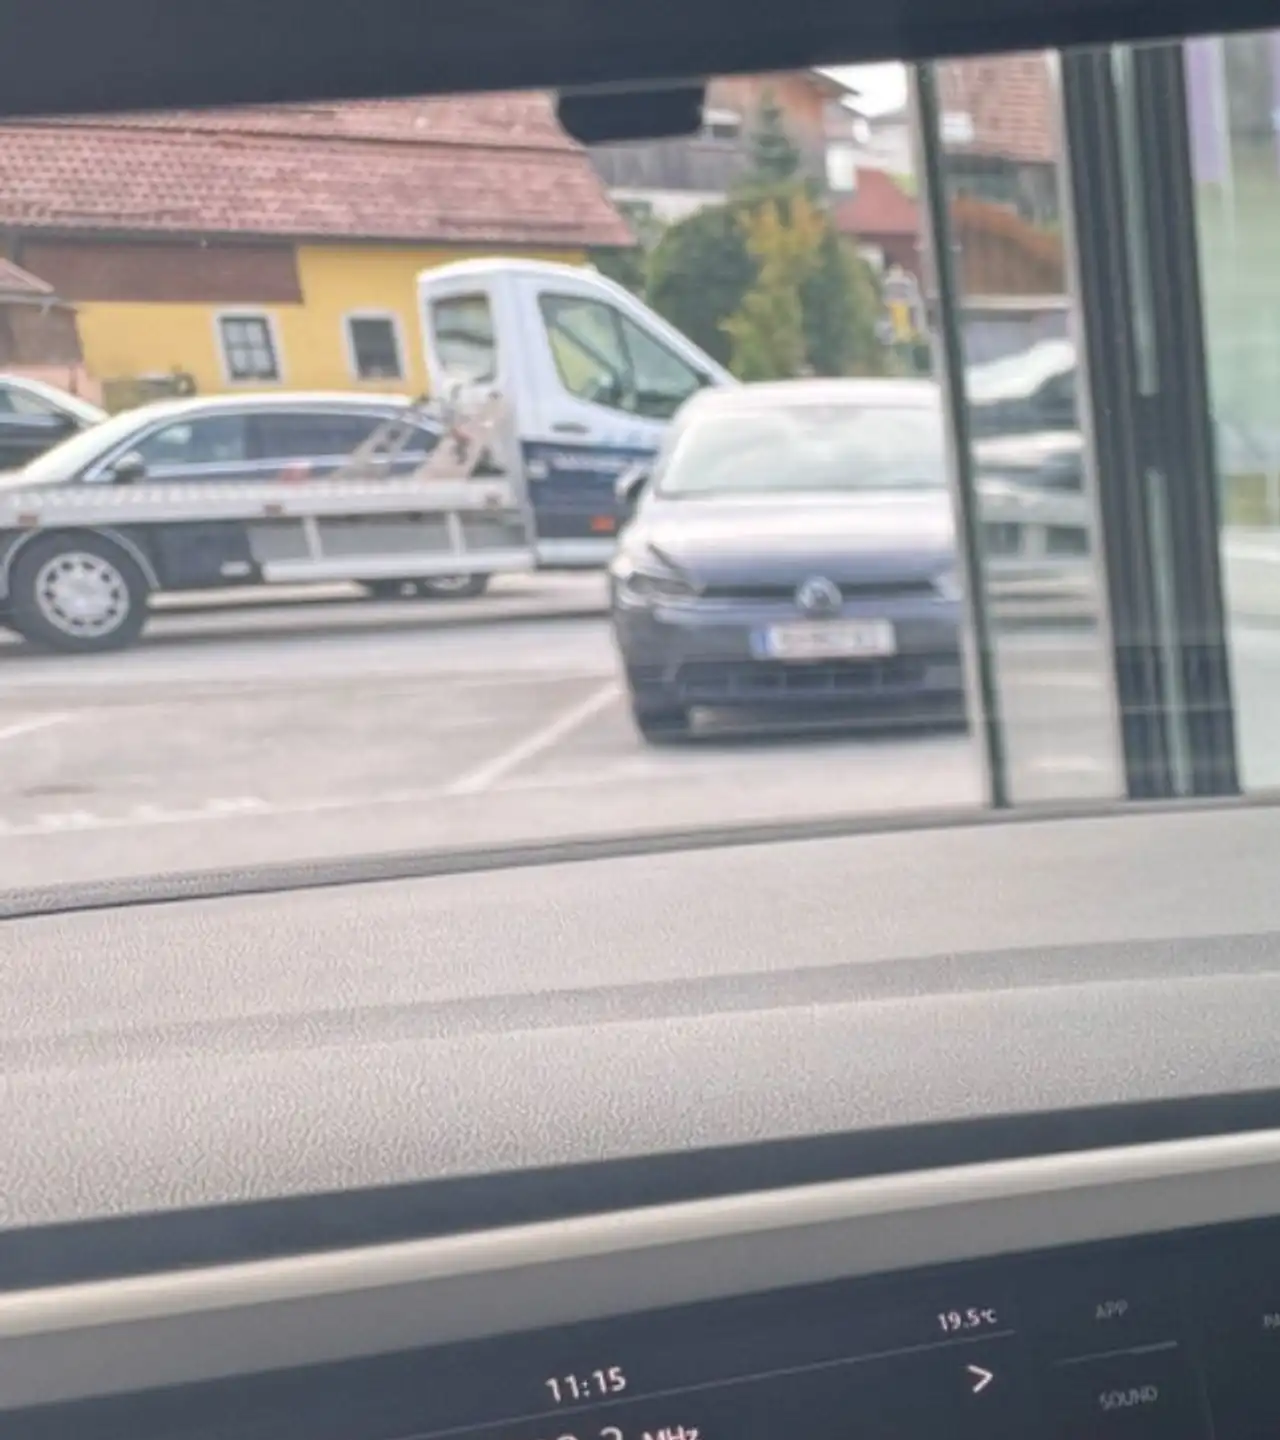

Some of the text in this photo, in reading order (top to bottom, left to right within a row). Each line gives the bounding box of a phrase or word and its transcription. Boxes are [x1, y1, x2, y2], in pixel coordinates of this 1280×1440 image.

[1096, 1300, 1129, 1319] APP
[545, 1366, 627, 1404] 11:15
[1099, 1385, 1159, 1411] SOUND
